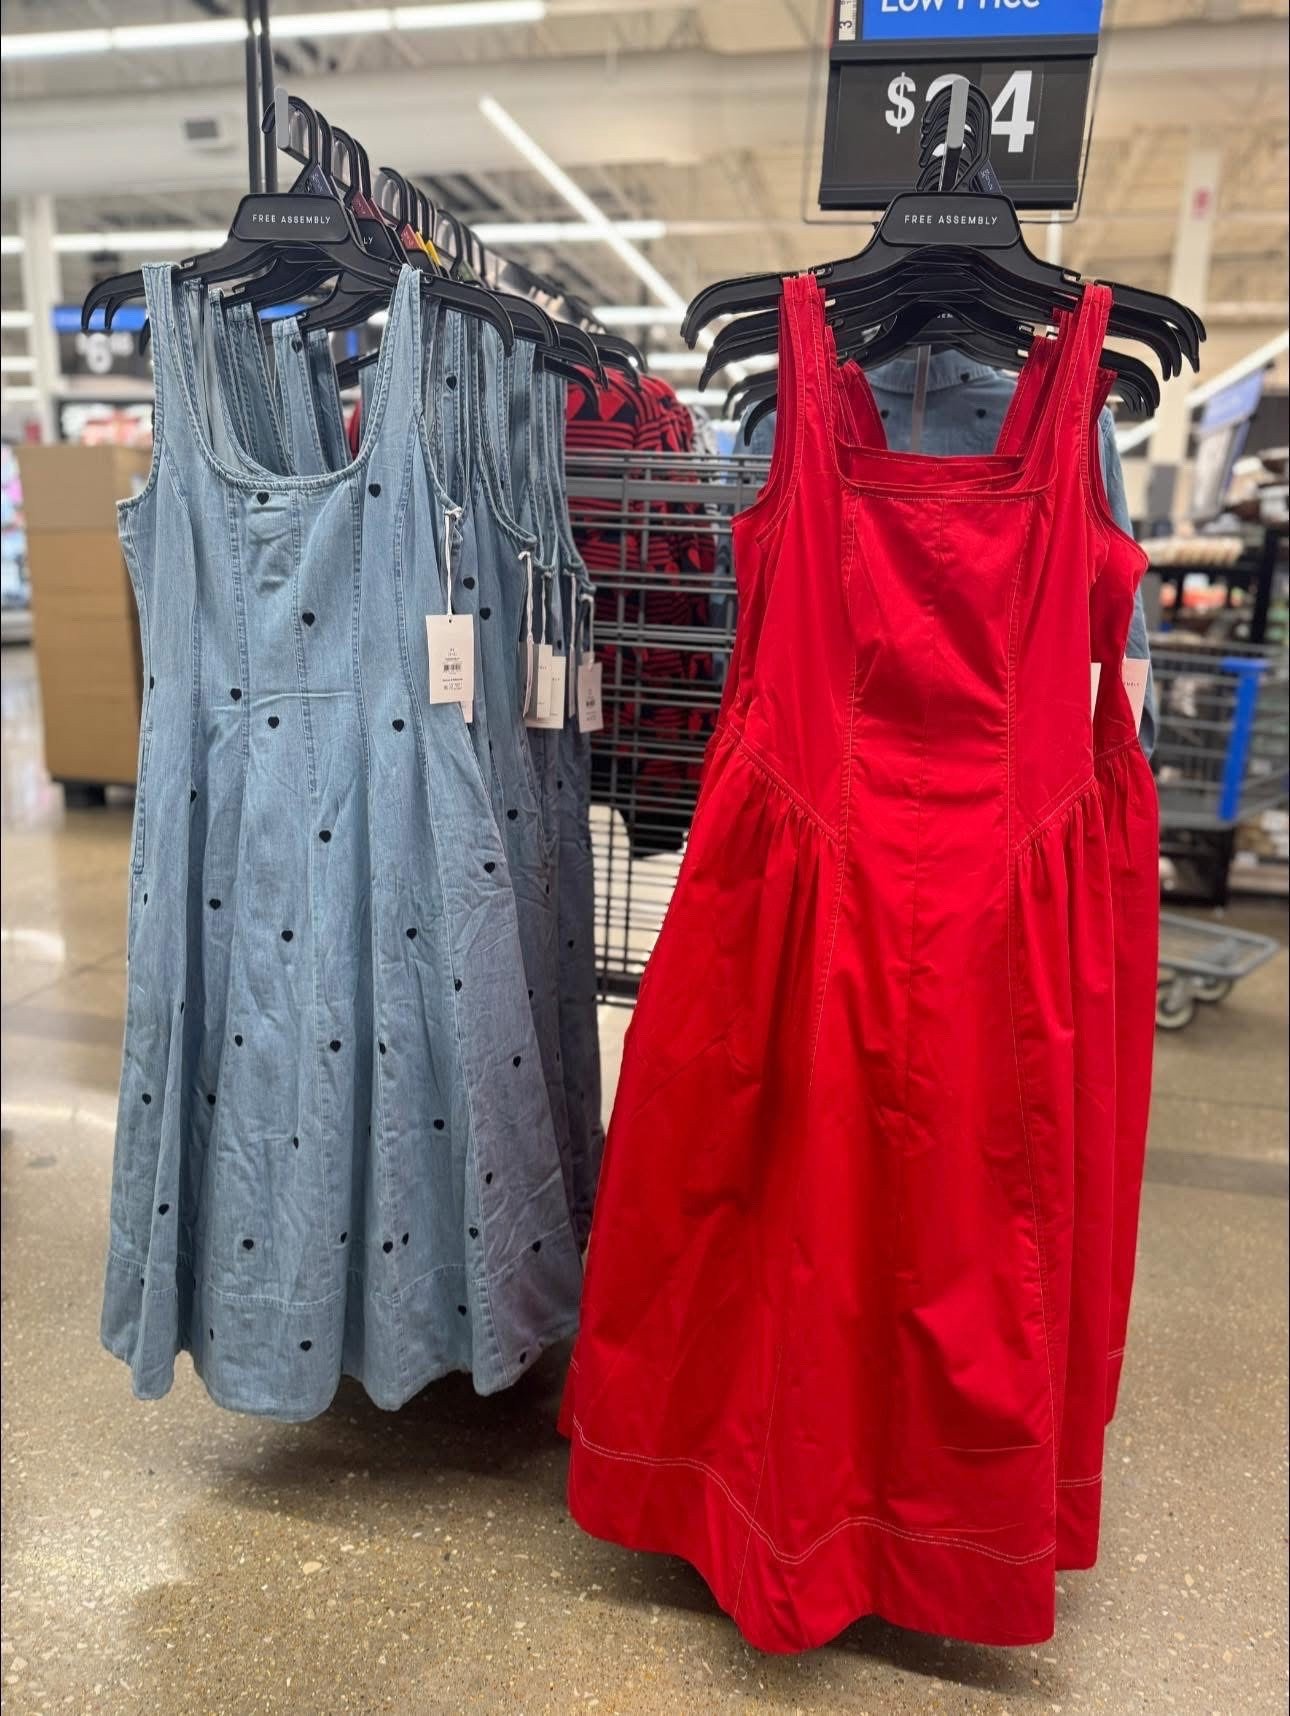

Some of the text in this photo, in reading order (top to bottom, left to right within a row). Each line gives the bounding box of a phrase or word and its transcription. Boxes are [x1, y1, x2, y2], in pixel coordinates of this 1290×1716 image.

[252, 214, 331, 224] FREE ASSEMBLY
[904, 215, 998, 225] FREE ASSEMBLY
